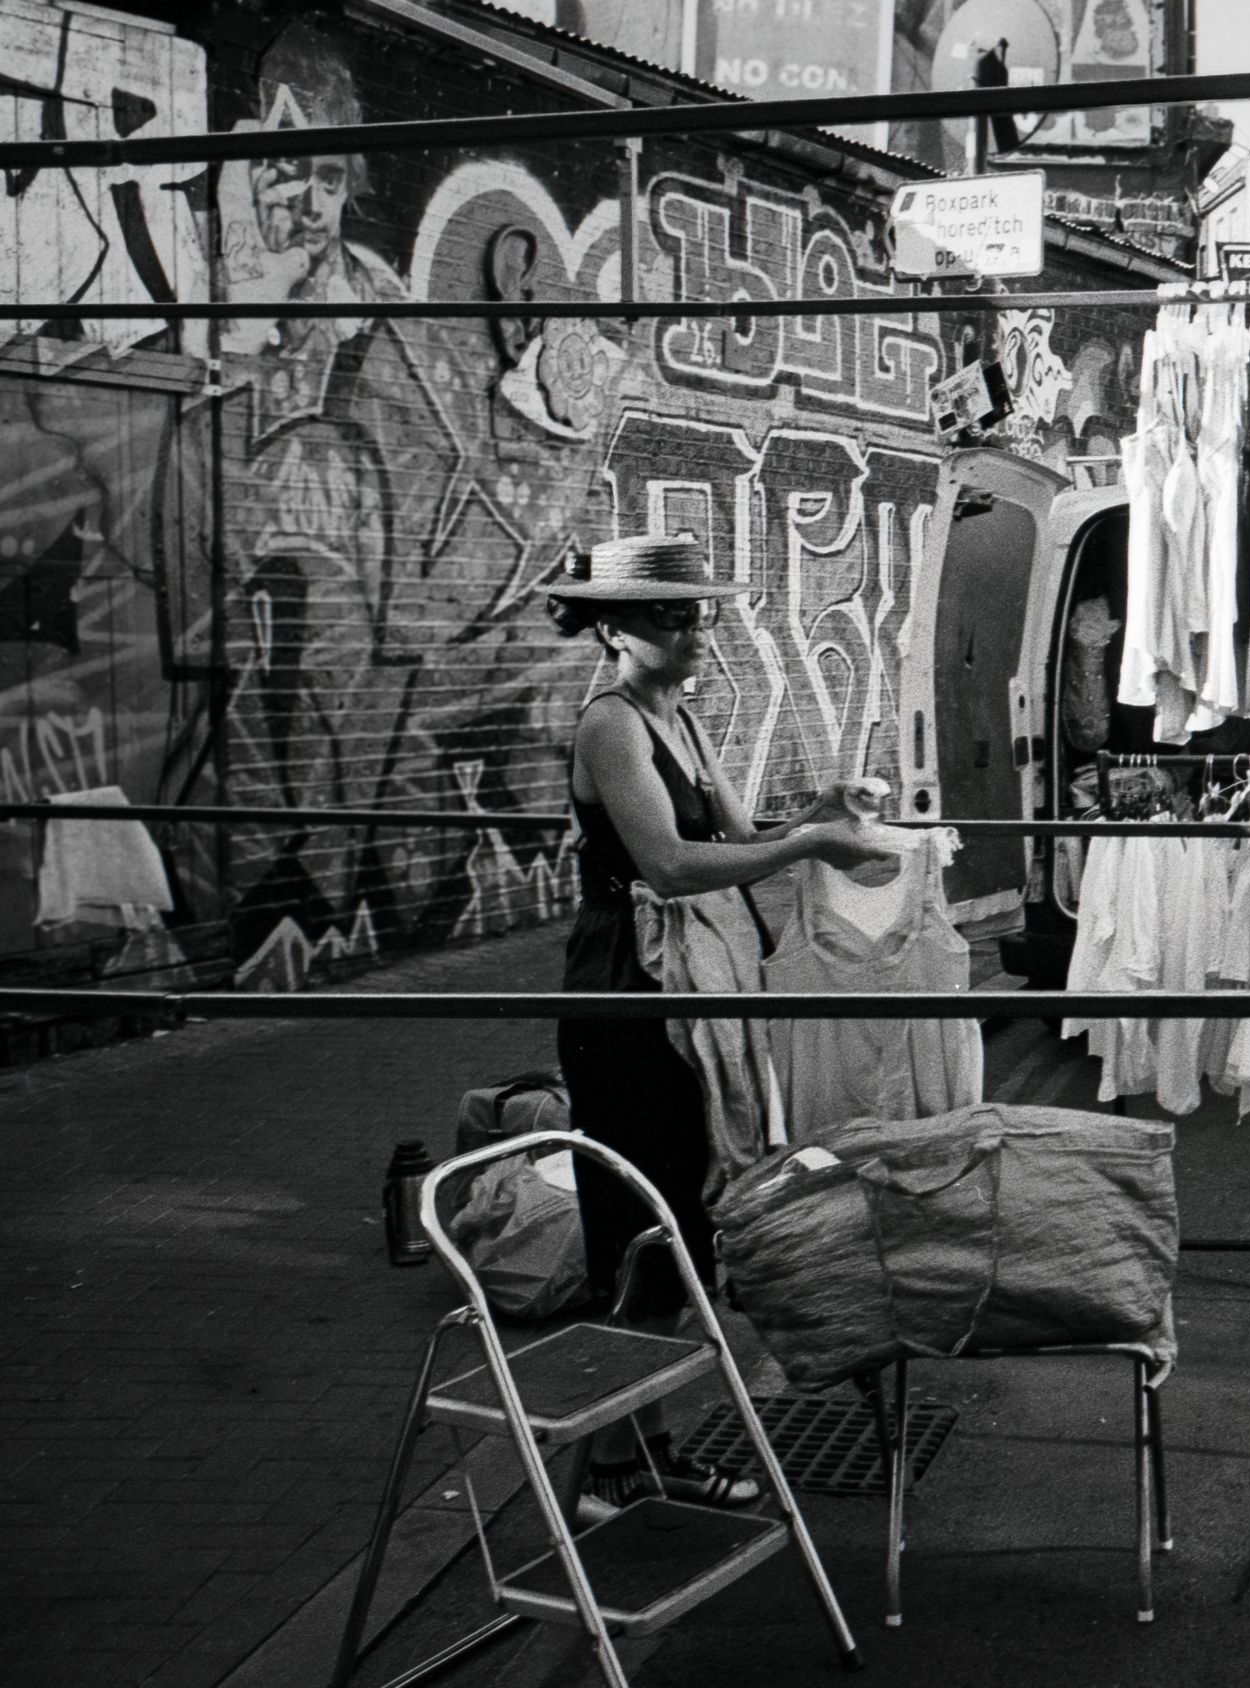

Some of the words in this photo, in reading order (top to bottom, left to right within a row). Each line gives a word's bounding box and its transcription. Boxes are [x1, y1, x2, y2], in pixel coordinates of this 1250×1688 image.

[714, 58, 768, 87] NO
[925, 189, 998, 214] Boxpark
[937, 214, 1023, 238] horeditch
